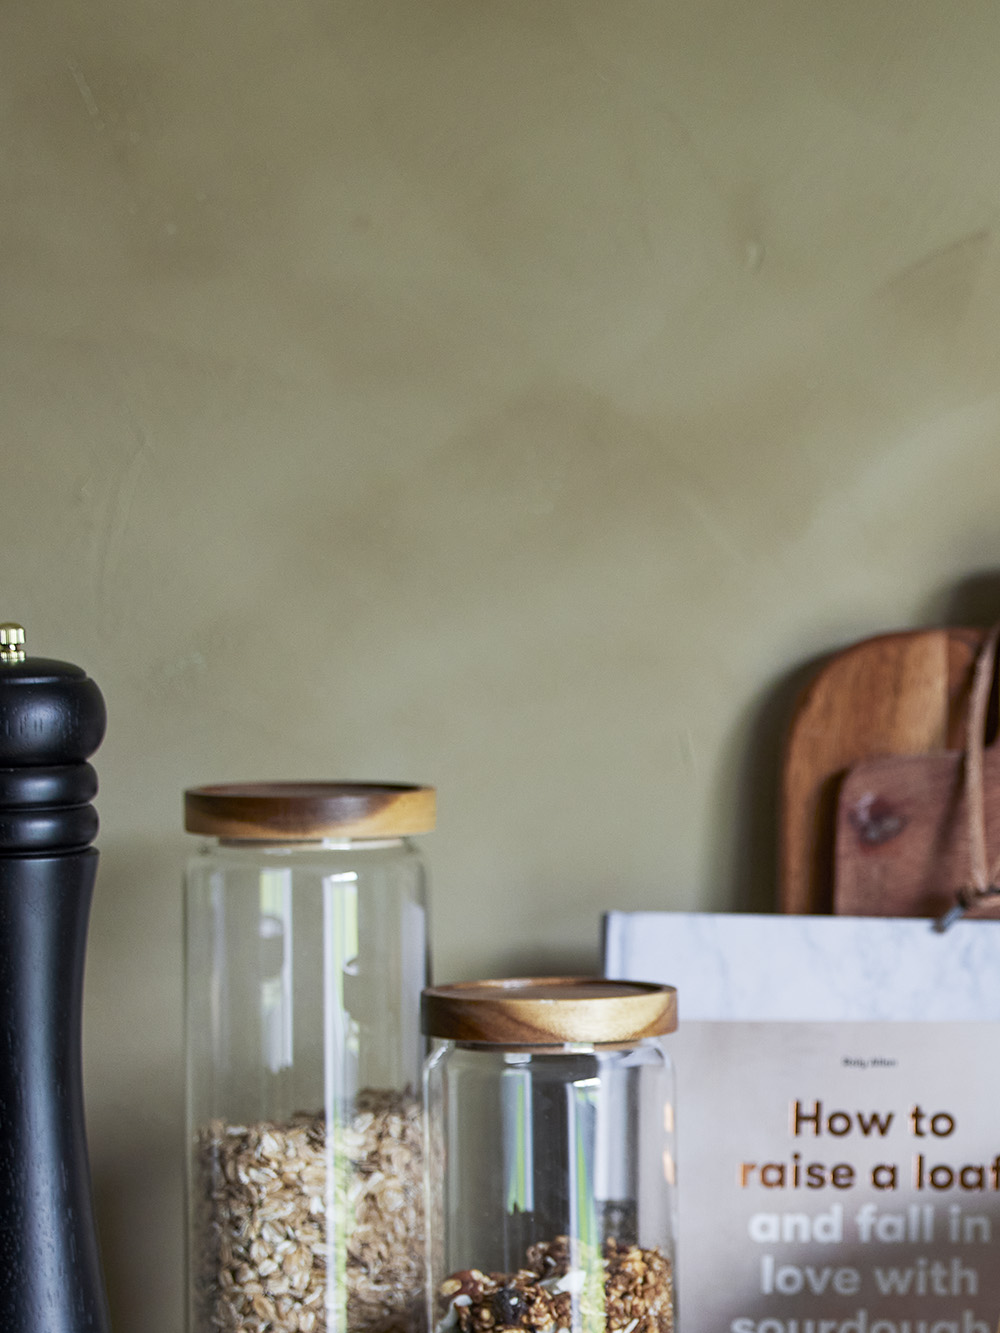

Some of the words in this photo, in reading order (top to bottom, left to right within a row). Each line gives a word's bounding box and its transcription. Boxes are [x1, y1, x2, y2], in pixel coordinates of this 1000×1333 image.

[793, 1099, 894, 1136] How
[911, 1105, 955, 1137] to
[738, 1153, 855, 1190] raise
[872, 1164, 898, 1190] a
[749, 1204, 843, 1243] and
[856, 1205, 934, 1242] fall
[949, 1206, 990, 1242] in
[761, 1255, 860, 1294] love
[875, 1258, 978, 1295] with
